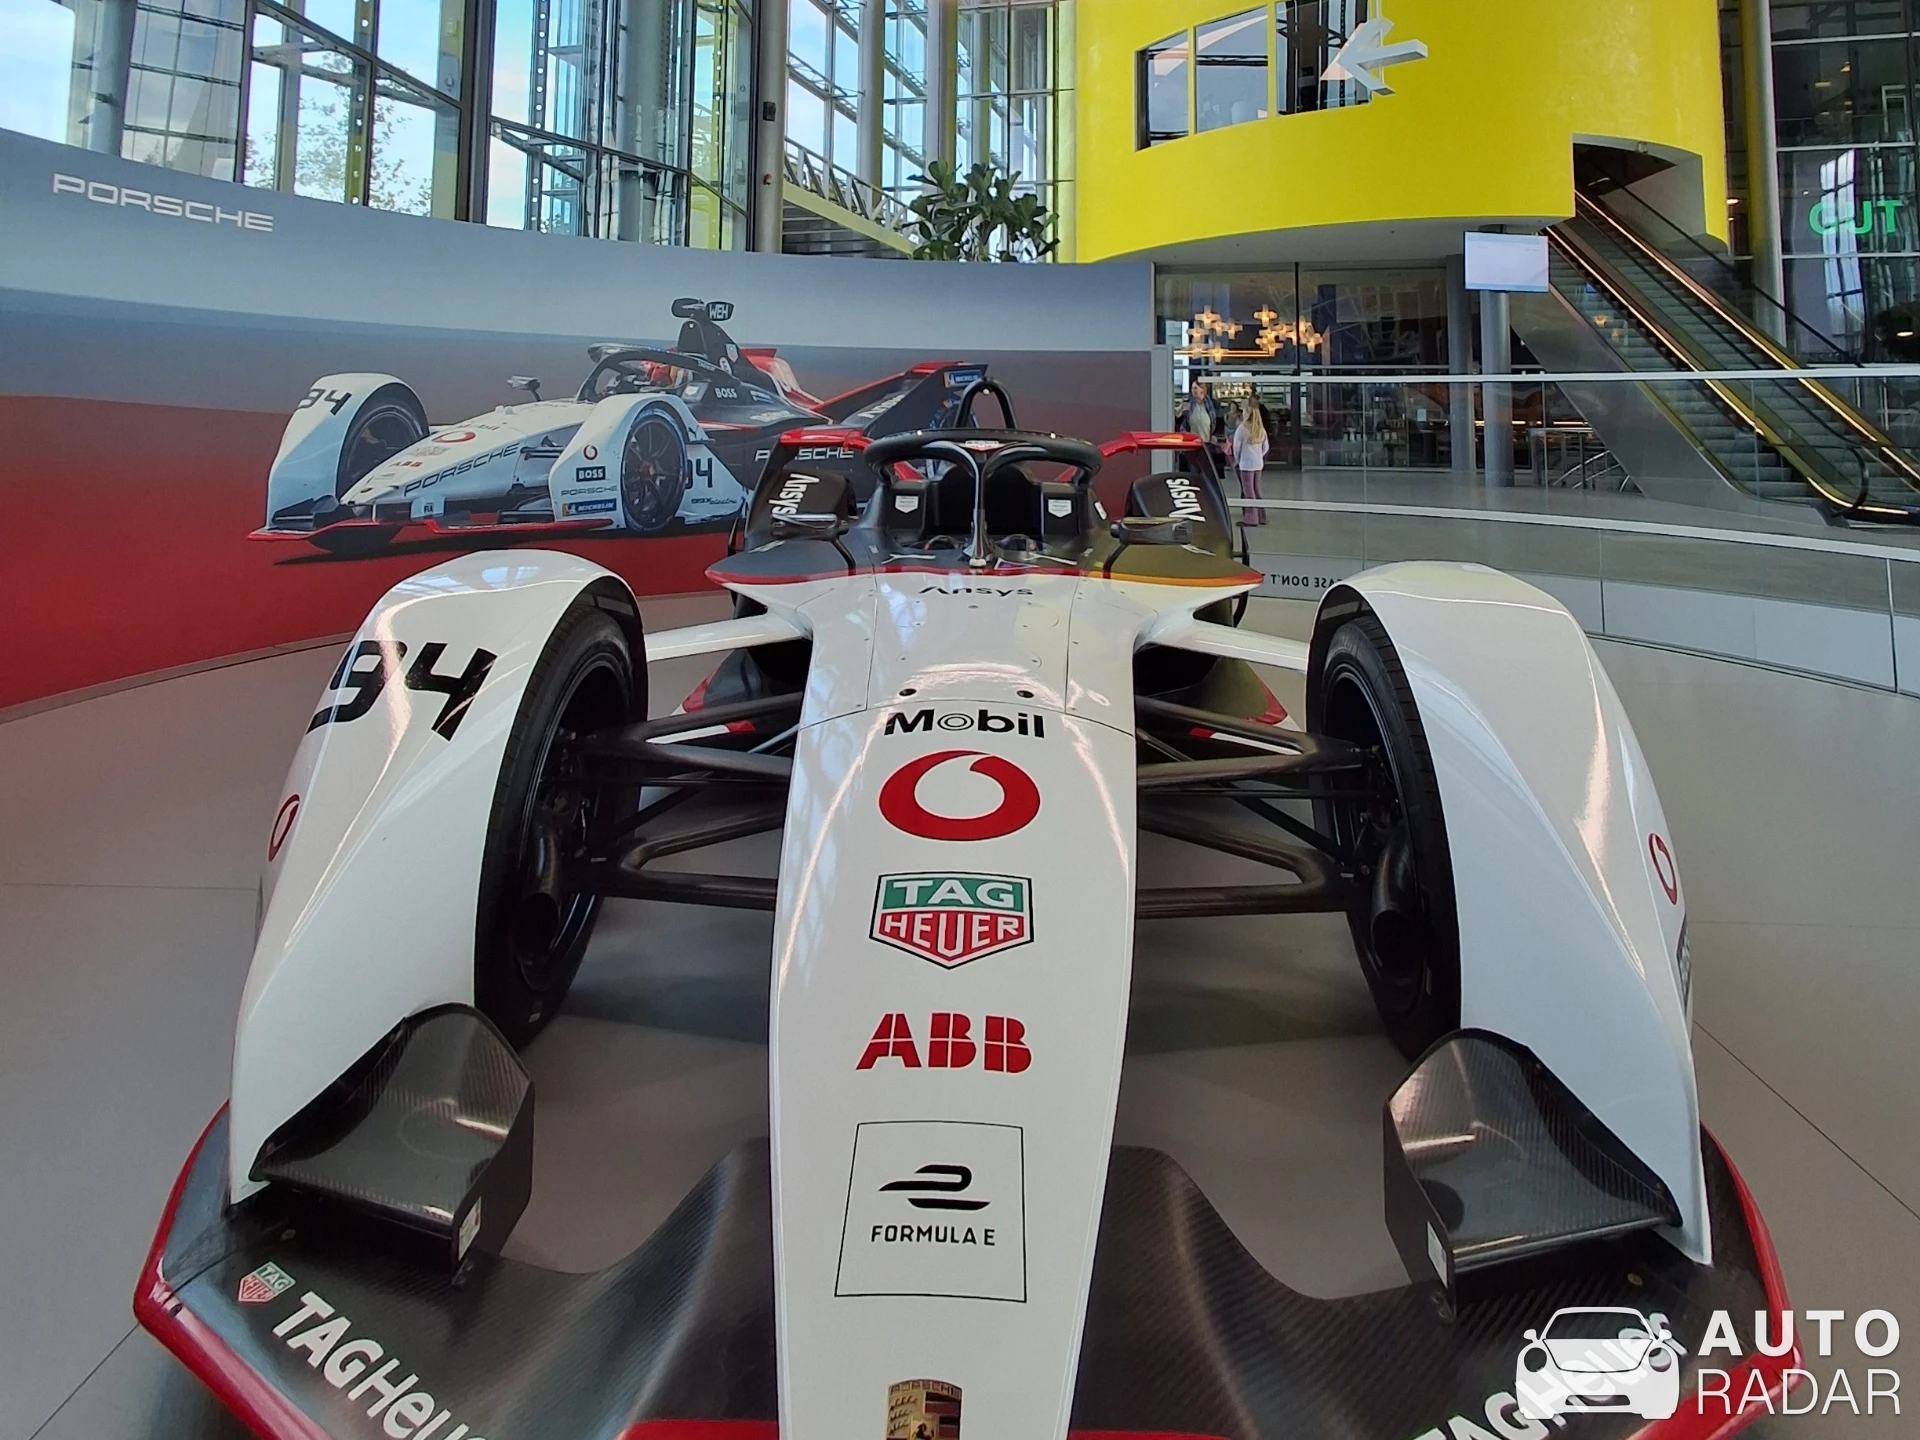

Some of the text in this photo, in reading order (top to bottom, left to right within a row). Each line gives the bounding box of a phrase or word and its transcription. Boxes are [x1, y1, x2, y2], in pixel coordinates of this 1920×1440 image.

[53, 173, 274, 232] PORSCHE
[709, 303, 728, 319] WEH
[714, 387, 738, 398] BOSS
[404, 442, 520, 497] PORSCHE
[755, 448, 854, 462] PSCHE
[578, 468, 604, 479] BOSS
[561, 485, 618, 496] PORSCHE
[769, 473, 820, 514] Ansys
[1166, 478, 1206, 522] Ansys
[919, 586, 1033, 597] Ansys
[306, 640, 497, 741] 94
[883, 708, 1045, 739] Mobil
[892, 879, 1015, 908] TAG
[883, 912, 1020, 957] HEUER
[856, 1012, 1032, 1074] ABB
[871, 1224, 996, 1246] FORMULA E
[260, 1265, 290, 1292] TAG
[272, 1291, 488, 1440] TAGHeu
